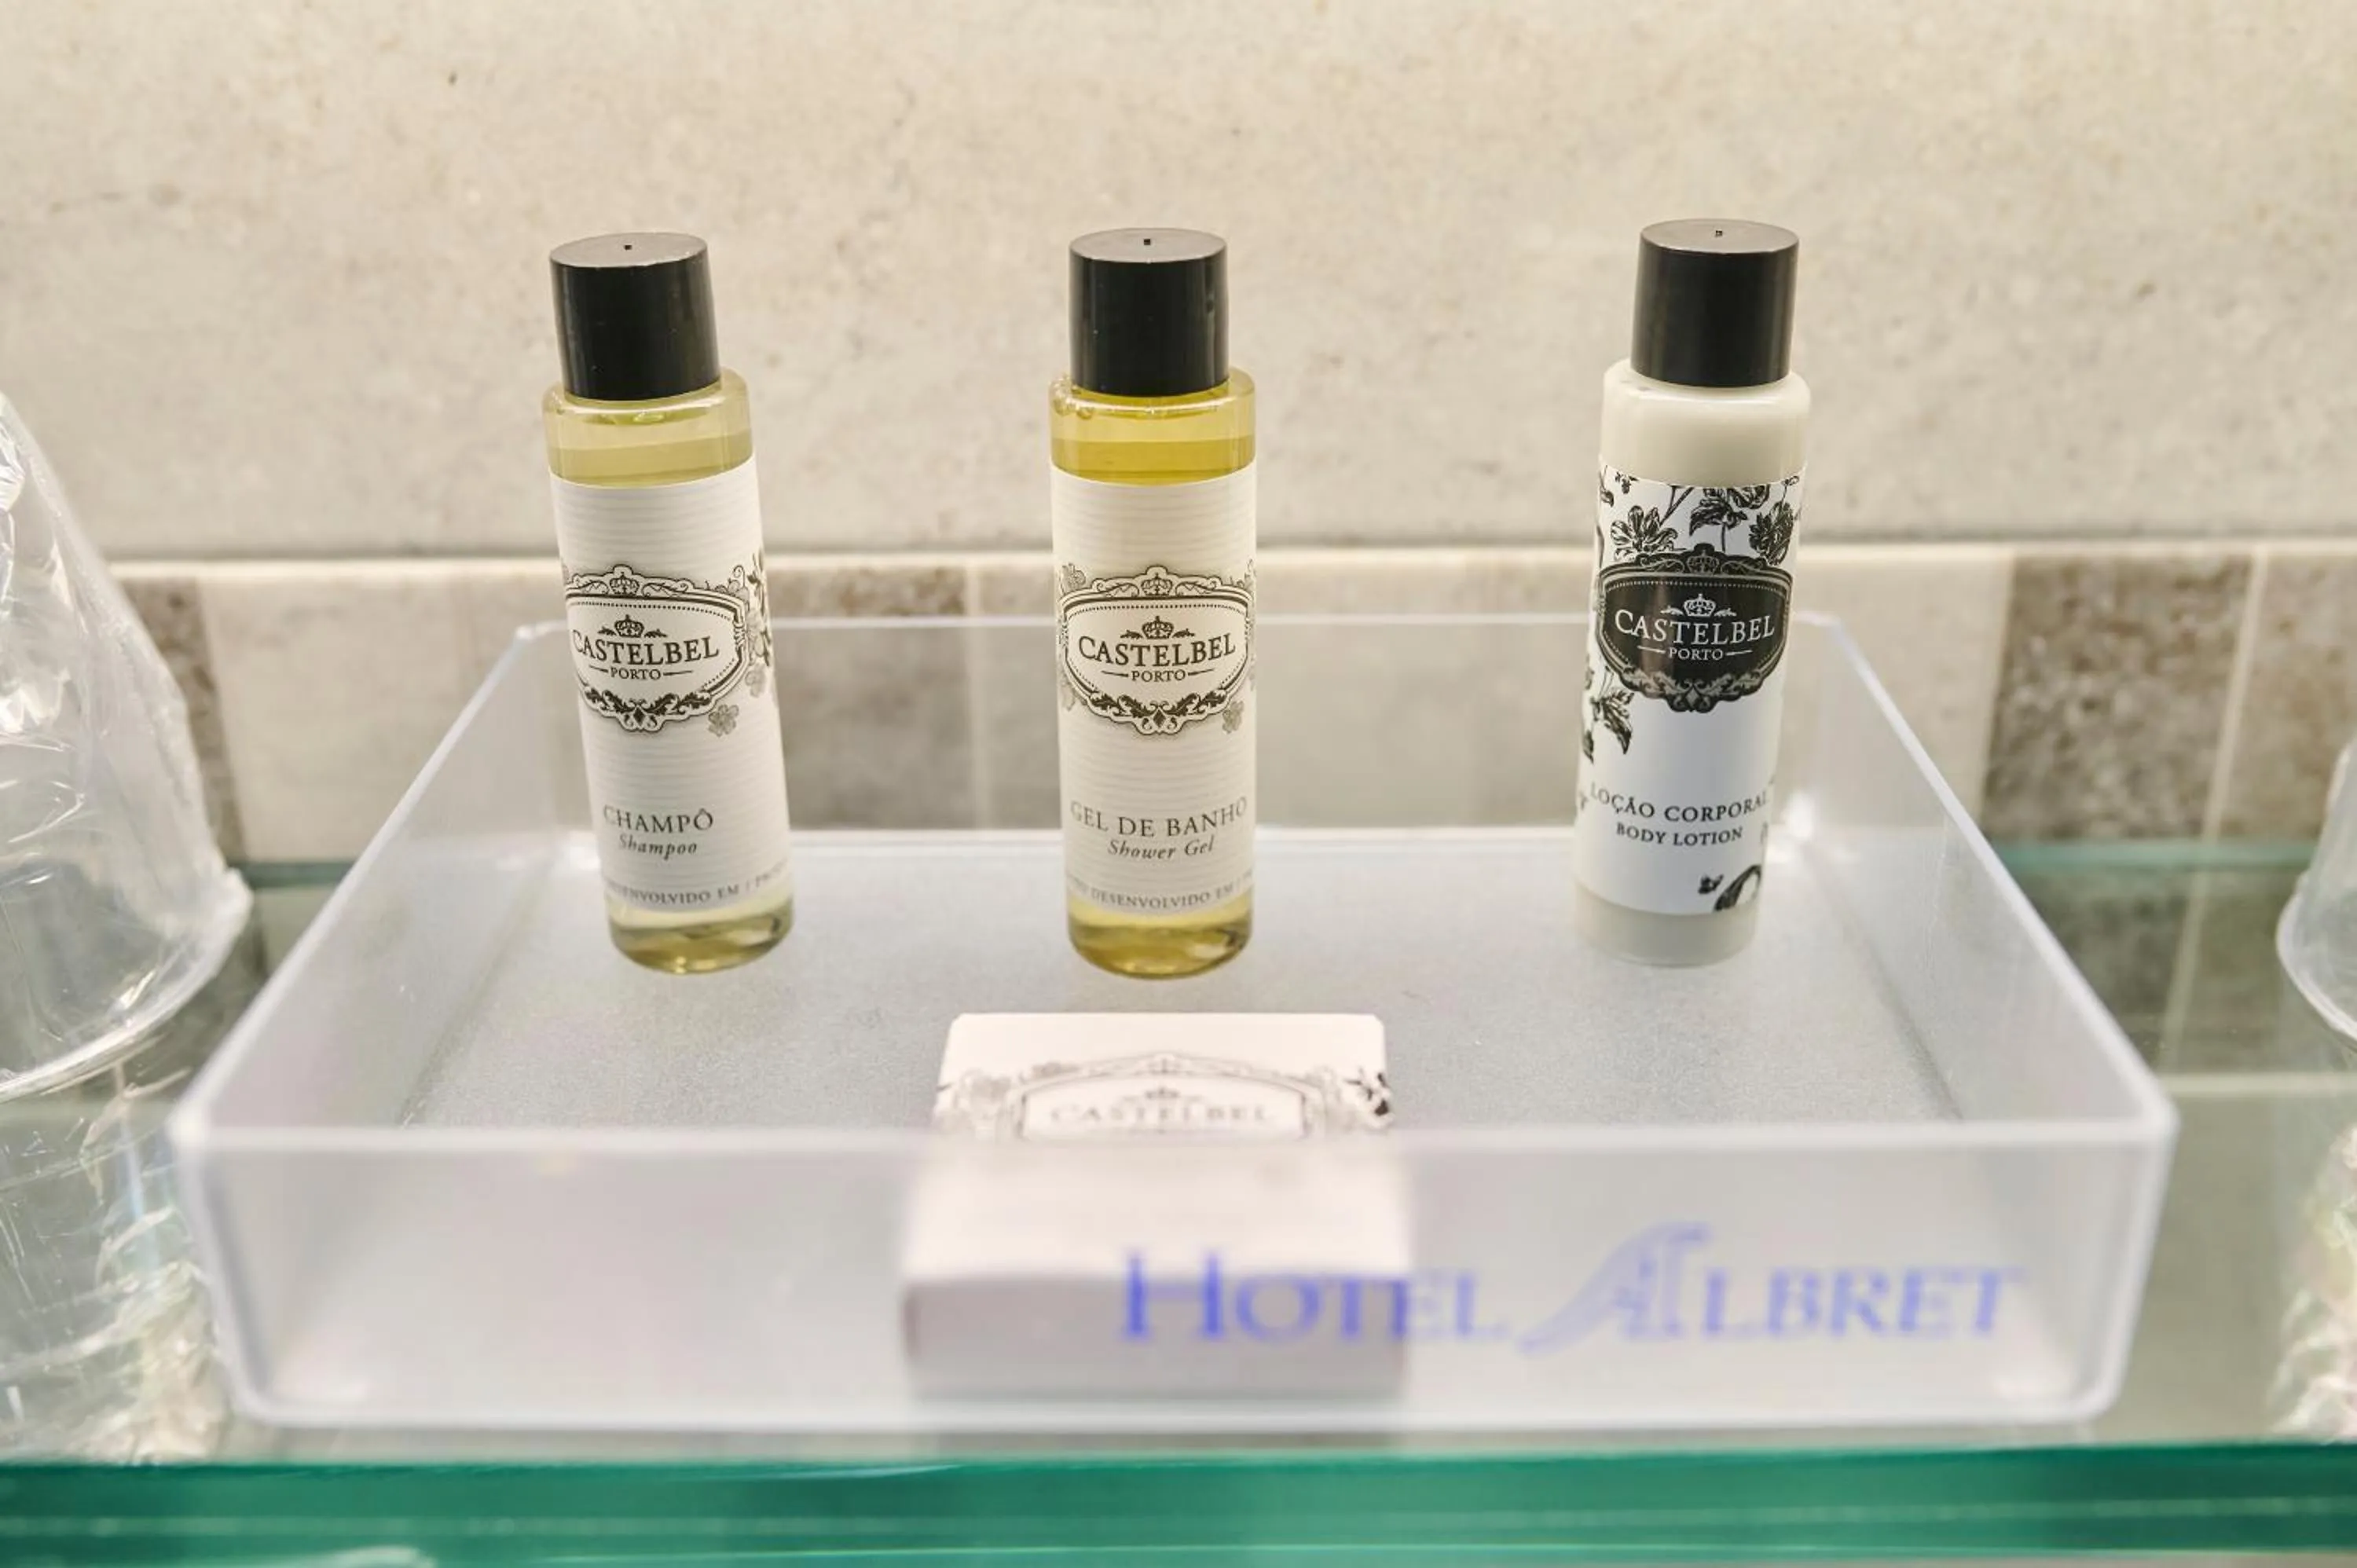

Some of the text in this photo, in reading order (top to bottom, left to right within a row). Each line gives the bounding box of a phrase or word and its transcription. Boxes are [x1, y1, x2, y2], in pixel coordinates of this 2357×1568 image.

[1615, 609, 1776, 646] CASTELBEL
[571, 628, 720, 666] CASTELBEL
[1078, 632, 1237, 668] CASTELBEL
[1668, 648, 1724, 661] PORTO
[610, 667, 662, 681] PORTO
[1131, 669, 1186, 683] PORTO
[1590, 782, 1655, 819] LOÇÃO
[603, 804, 714, 834] CHAMPÔ
[1069, 796, 1248, 838] GEL DE BANHO
[618, 833, 698, 861] Shampoo
[1106, 833, 1215, 860] Shower Gel
[1615, 822, 1743, 847] BODY LOTION
